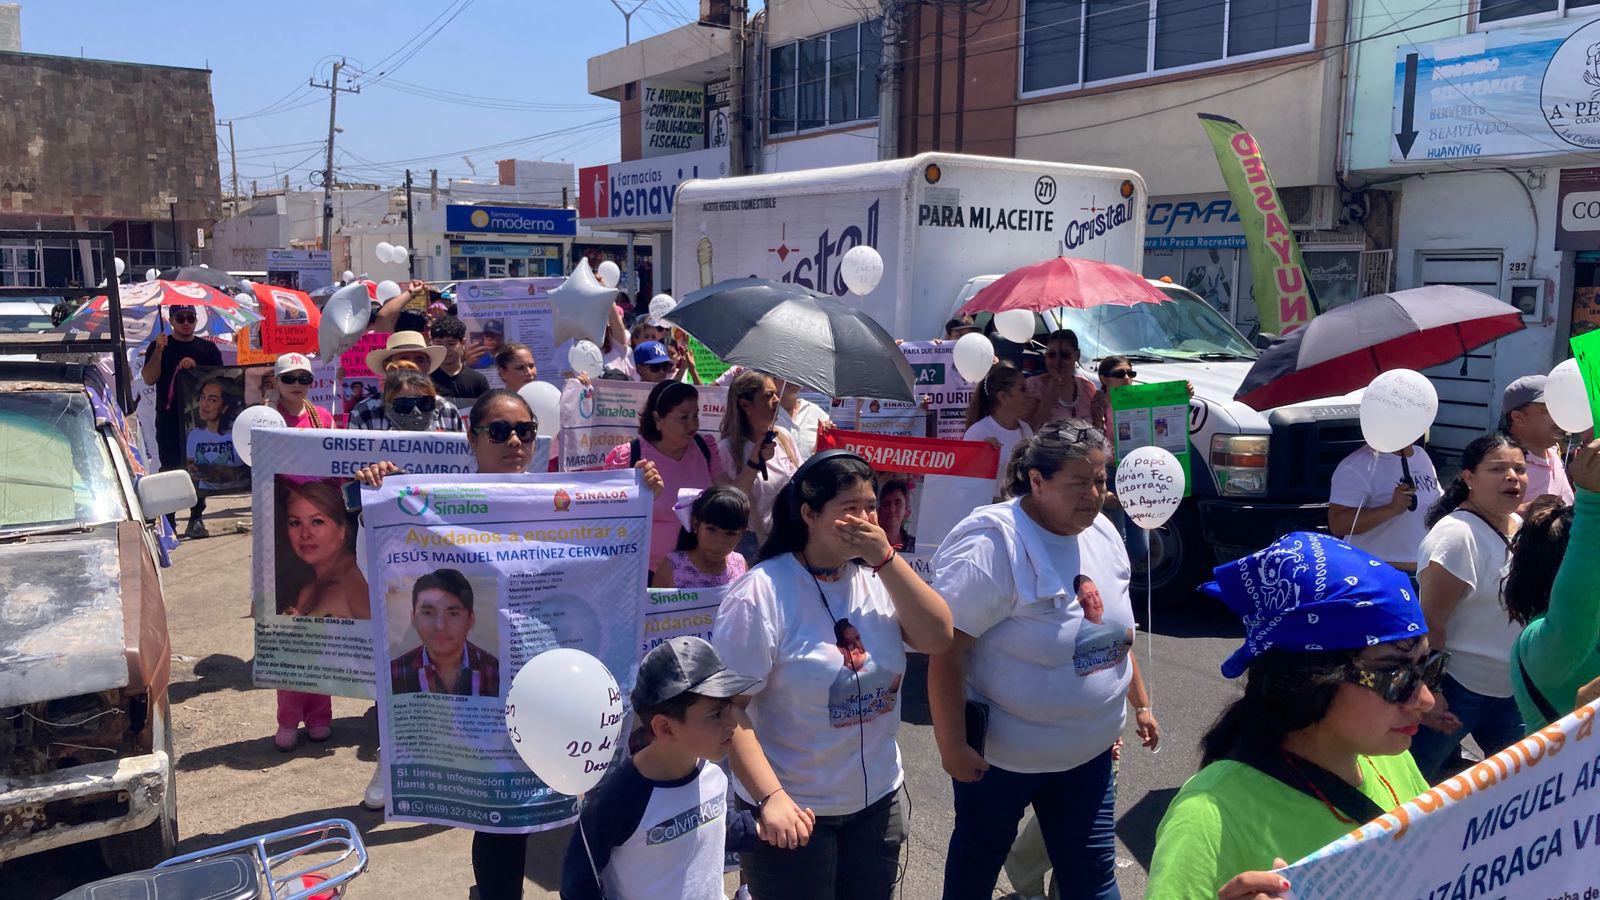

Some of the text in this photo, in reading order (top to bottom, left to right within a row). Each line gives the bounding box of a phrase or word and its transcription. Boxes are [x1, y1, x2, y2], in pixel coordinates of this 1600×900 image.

[646, 88, 704, 104] TE AYUDAMOS
[686, 106, 702, 120] CON
[656, 120, 704, 134] OBLIGACIONES
[650, 134, 692, 149] FISCALES
[1428, 144, 1482, 158] HUANYING
[618, 168, 662, 187] farmacias
[1038, 181, 1052, 198] 271
[719, 200, 740, 211] VEGETAL
[741, 198, 776, 210] COMESTIBLE
[491, 217, 554, 230] moderna
[918, 204, 965, 228] PARA
[1065, 197, 1134, 250] Cristal
[1144, 236, 1246, 248] ara la Pesca Recreativa
[1510, 262, 1526, 272] 292
[596, 404, 636, 418] Sinaloa
[323, 437, 375, 451] GRISET
[566, 454, 599, 466] MARCOS
[404, 464, 470, 474] GAMBOA
[576, 490, 628, 500] SINALOA
[433, 501, 489, 515] Sinaloa
[406, 524, 628, 548] Ayúdanos a encontrar a
[387, 542, 638, 564] JESÚS MANUEL MARTÍNEZ CERVANTES
[650, 590, 698, 605] Sinaloa
[566, 741, 592, 757] 20
[397, 768, 408, 777] Si
[412, 769, 442, 779] tienes
[446, 773, 505, 787] información
[397, 780, 425, 789] llama
[494, 789, 507, 799] Tu
[510, 788, 544, 800] ayuda
[426, 803, 488, 820] (669) 327 8424
[1462, 772, 1566, 850] MIGUEL
[649, 814, 700, 842] Calvin
